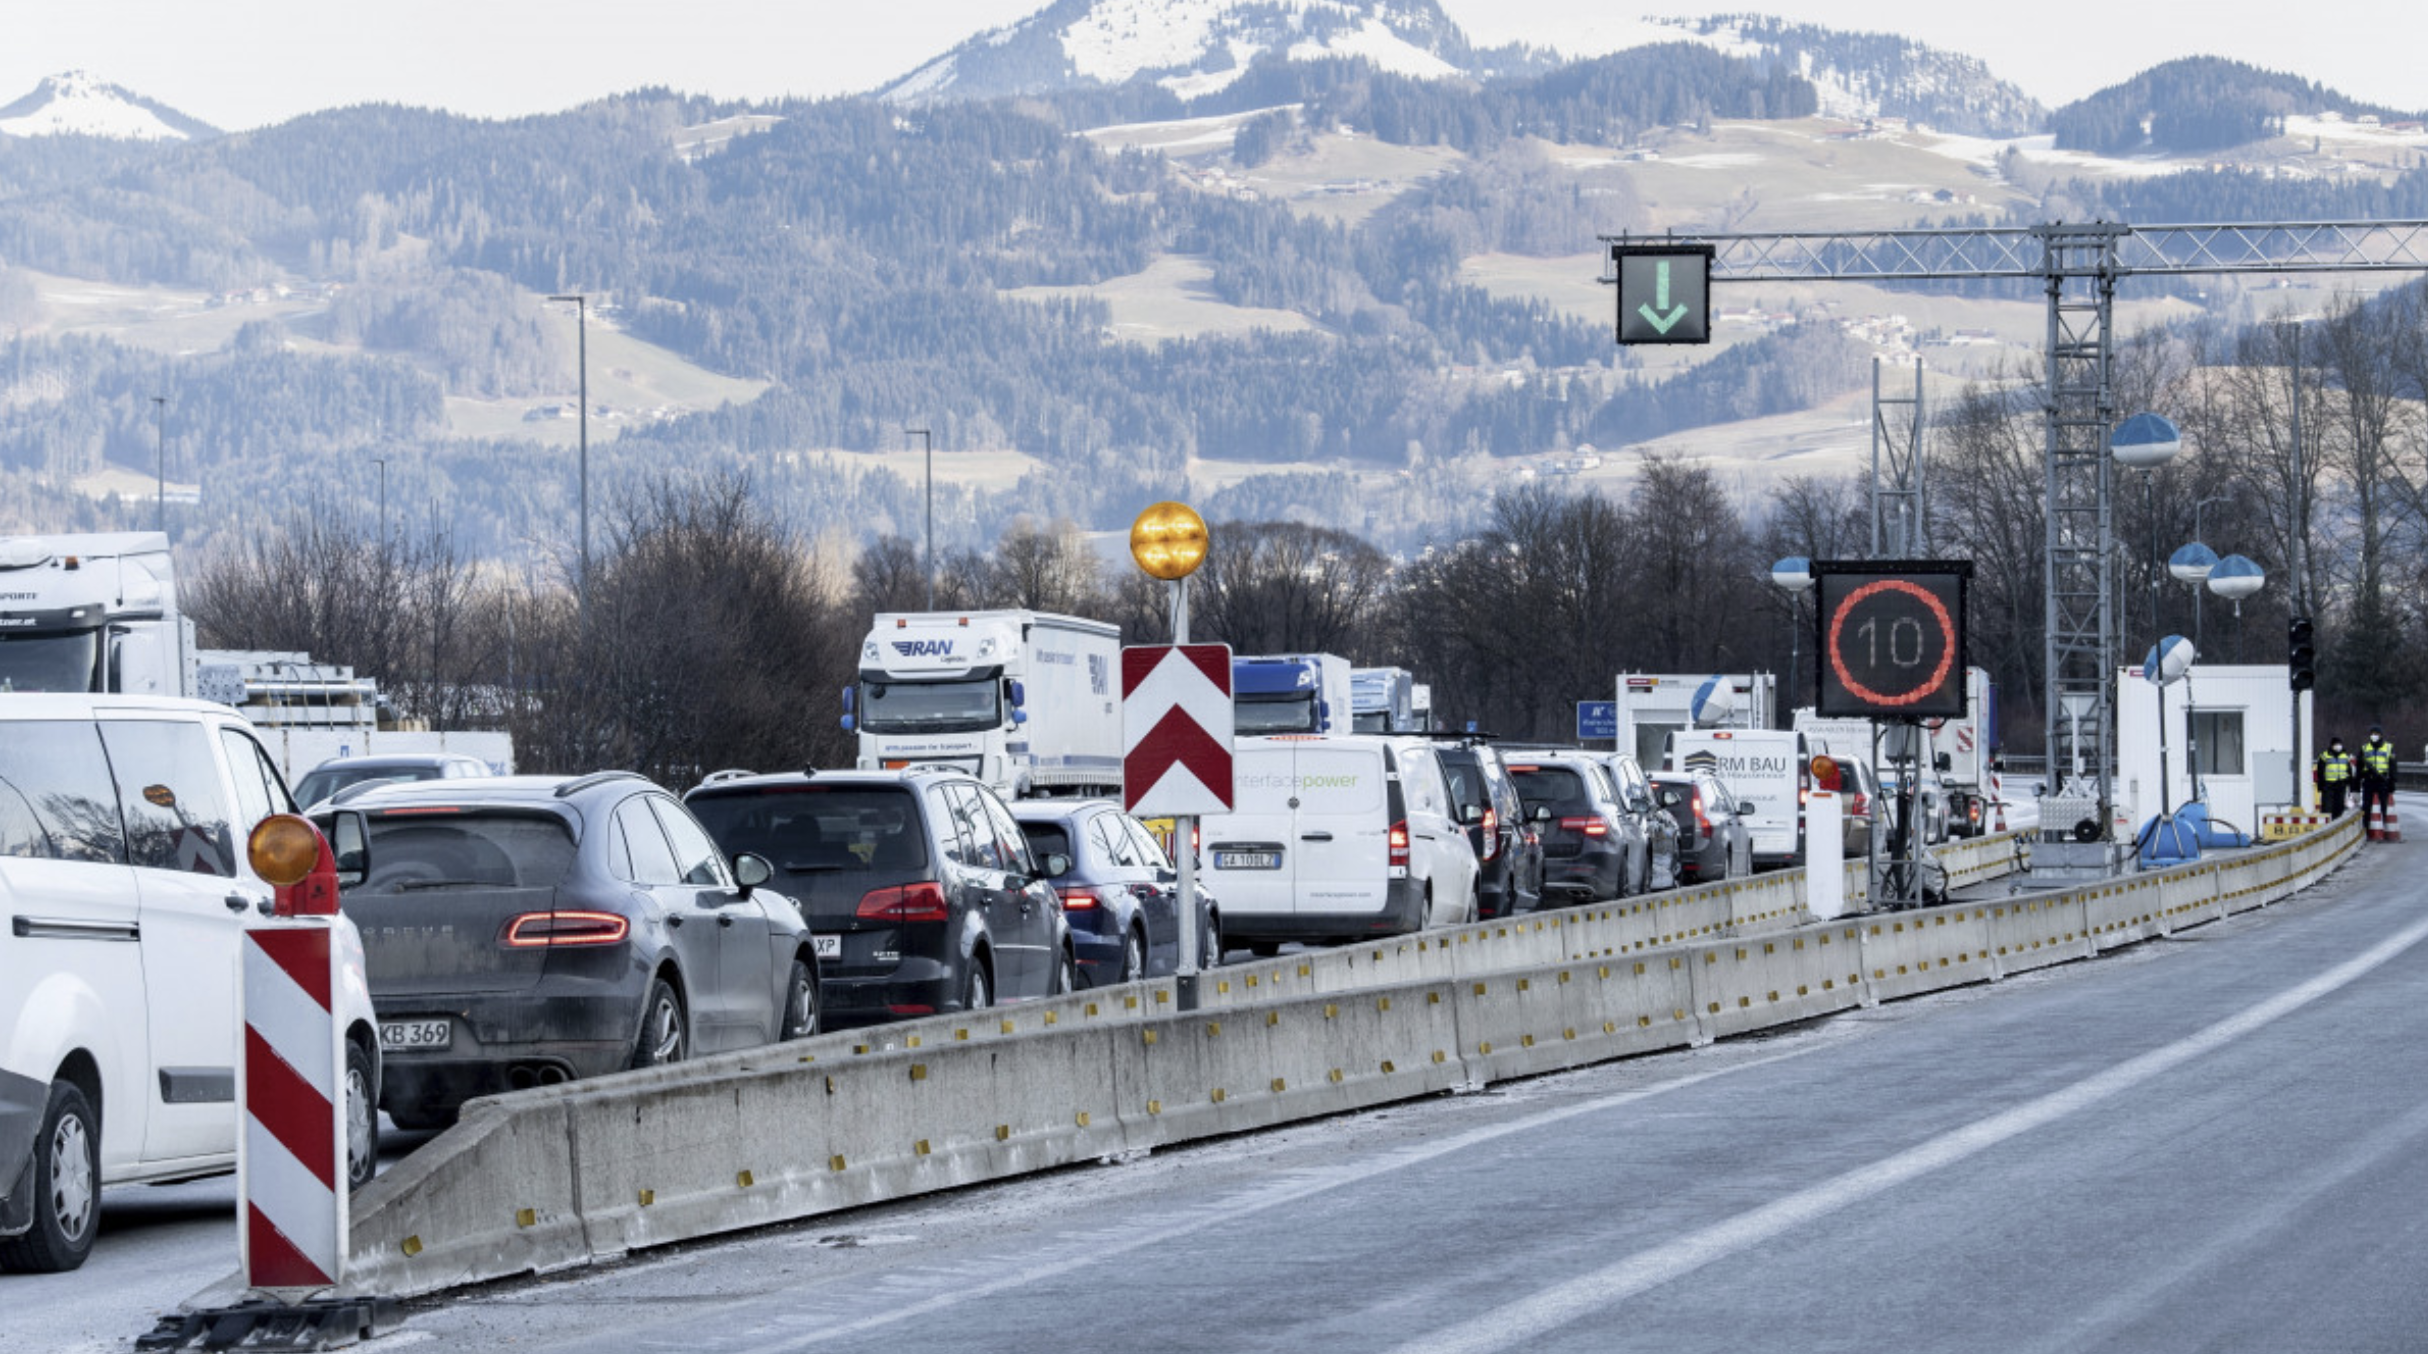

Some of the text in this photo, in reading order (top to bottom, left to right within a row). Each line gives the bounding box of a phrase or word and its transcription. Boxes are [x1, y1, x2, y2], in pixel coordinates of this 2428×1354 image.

[1857, 616, 1924, 668] 10
[1718, 757, 1786, 773] RM BAU
[1233, 774, 1358, 790] nterfacepower
[817, 938, 836, 953] XP
[409, 1022, 448, 1044] 369
